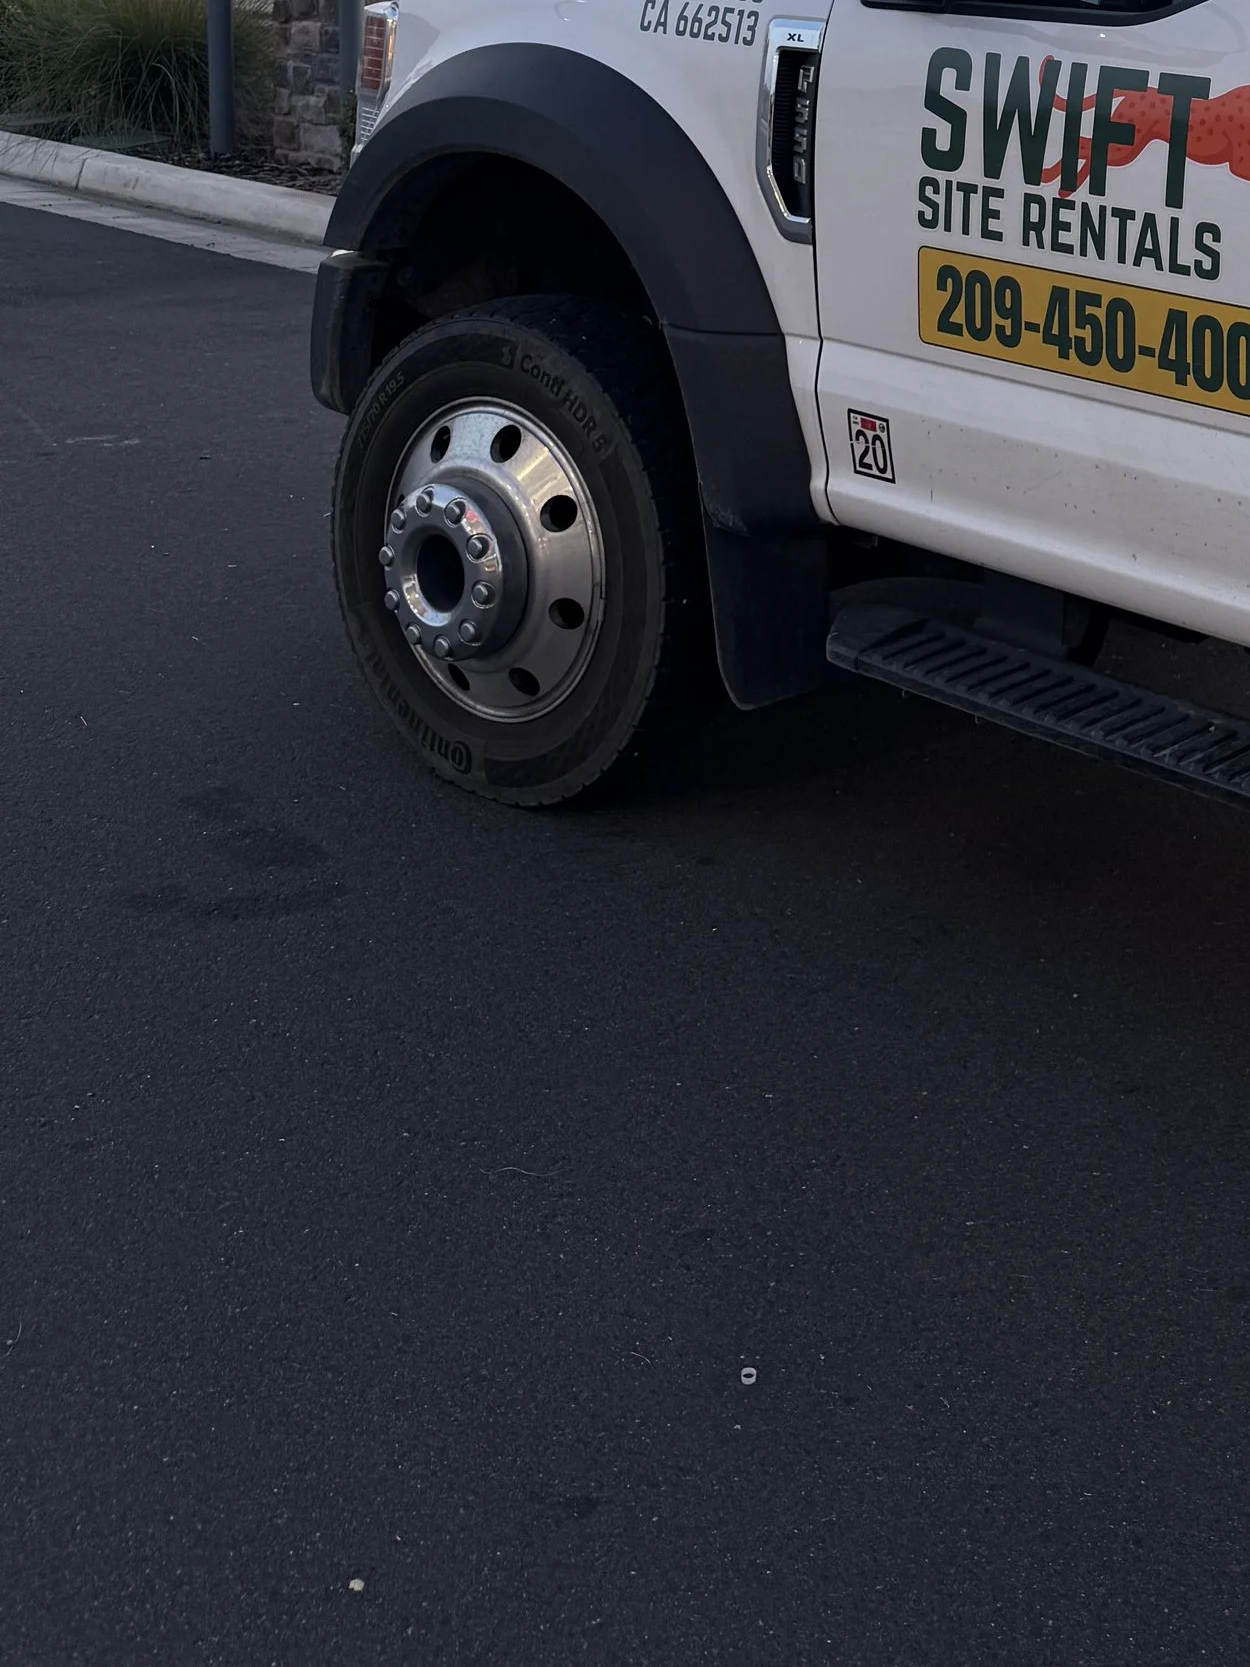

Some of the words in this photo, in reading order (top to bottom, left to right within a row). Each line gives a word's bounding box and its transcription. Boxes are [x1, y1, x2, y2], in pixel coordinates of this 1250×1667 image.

[674, 1, 760, 47] 662513
[786, 32, 805, 43] XL
[920, 46, 1212, 210] SWIFT
[917, 175, 1006, 243] SITE
[1022, 192, 1222, 281] RENTALS
[855, 429, 888, 475] 20
